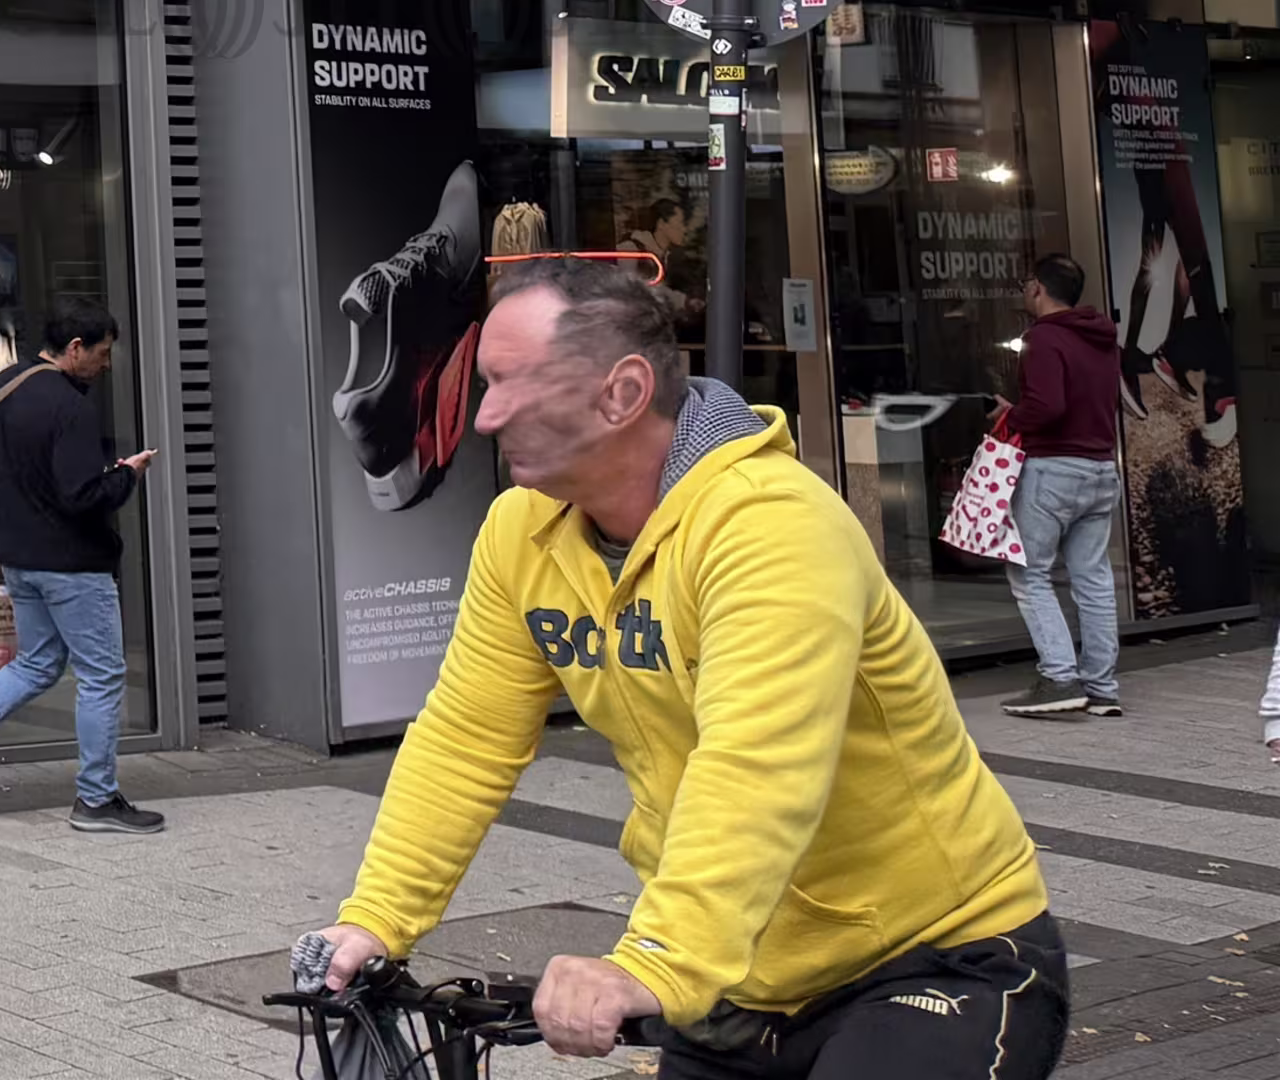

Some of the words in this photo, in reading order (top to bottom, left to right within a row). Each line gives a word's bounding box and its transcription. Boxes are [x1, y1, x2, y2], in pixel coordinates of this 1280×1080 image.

[312, 23, 428, 56] DYNAMIC
[314, 60, 429, 92] SUPPORT
[1108, 74, 1178, 99] DYNAMIC
[315, 94, 357, 107] STABILITY
[358, 96, 371, 107] ON
[372, 97, 388, 108] ALL
[389, 98, 432, 110] SURFACES
[1111, 102, 1180, 127] SUPPORT
[917, 210, 1018, 240] DYNAMIC
[920, 251, 1020, 280] SUPPORT
[363, 606, 393, 619] ACTIVE
[394, 602, 430, 617] CHASSIS
